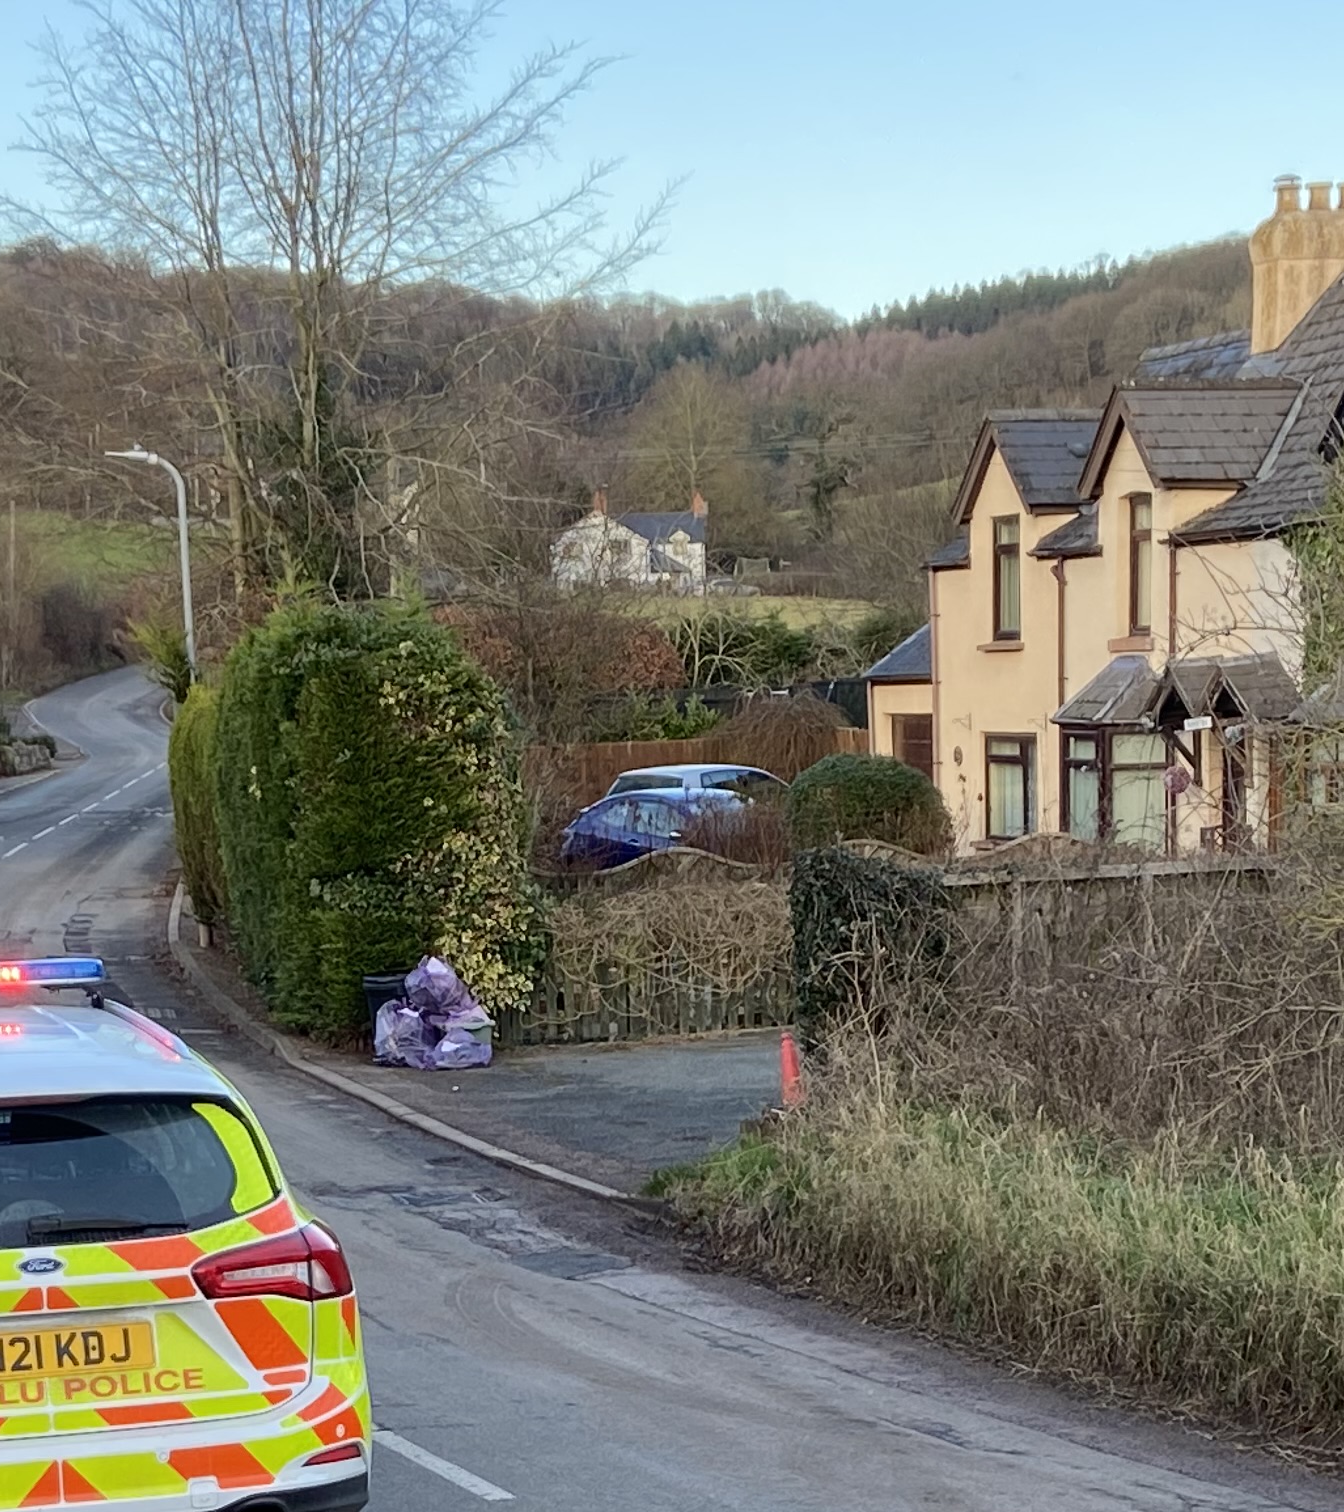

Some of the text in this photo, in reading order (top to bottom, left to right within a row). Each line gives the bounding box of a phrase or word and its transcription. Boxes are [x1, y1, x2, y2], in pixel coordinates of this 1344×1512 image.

[27, 1260, 55, 1271] Ford
[55, 1327, 132, 1368] KDJ
[63, 1368, 205, 1401] POLICE
